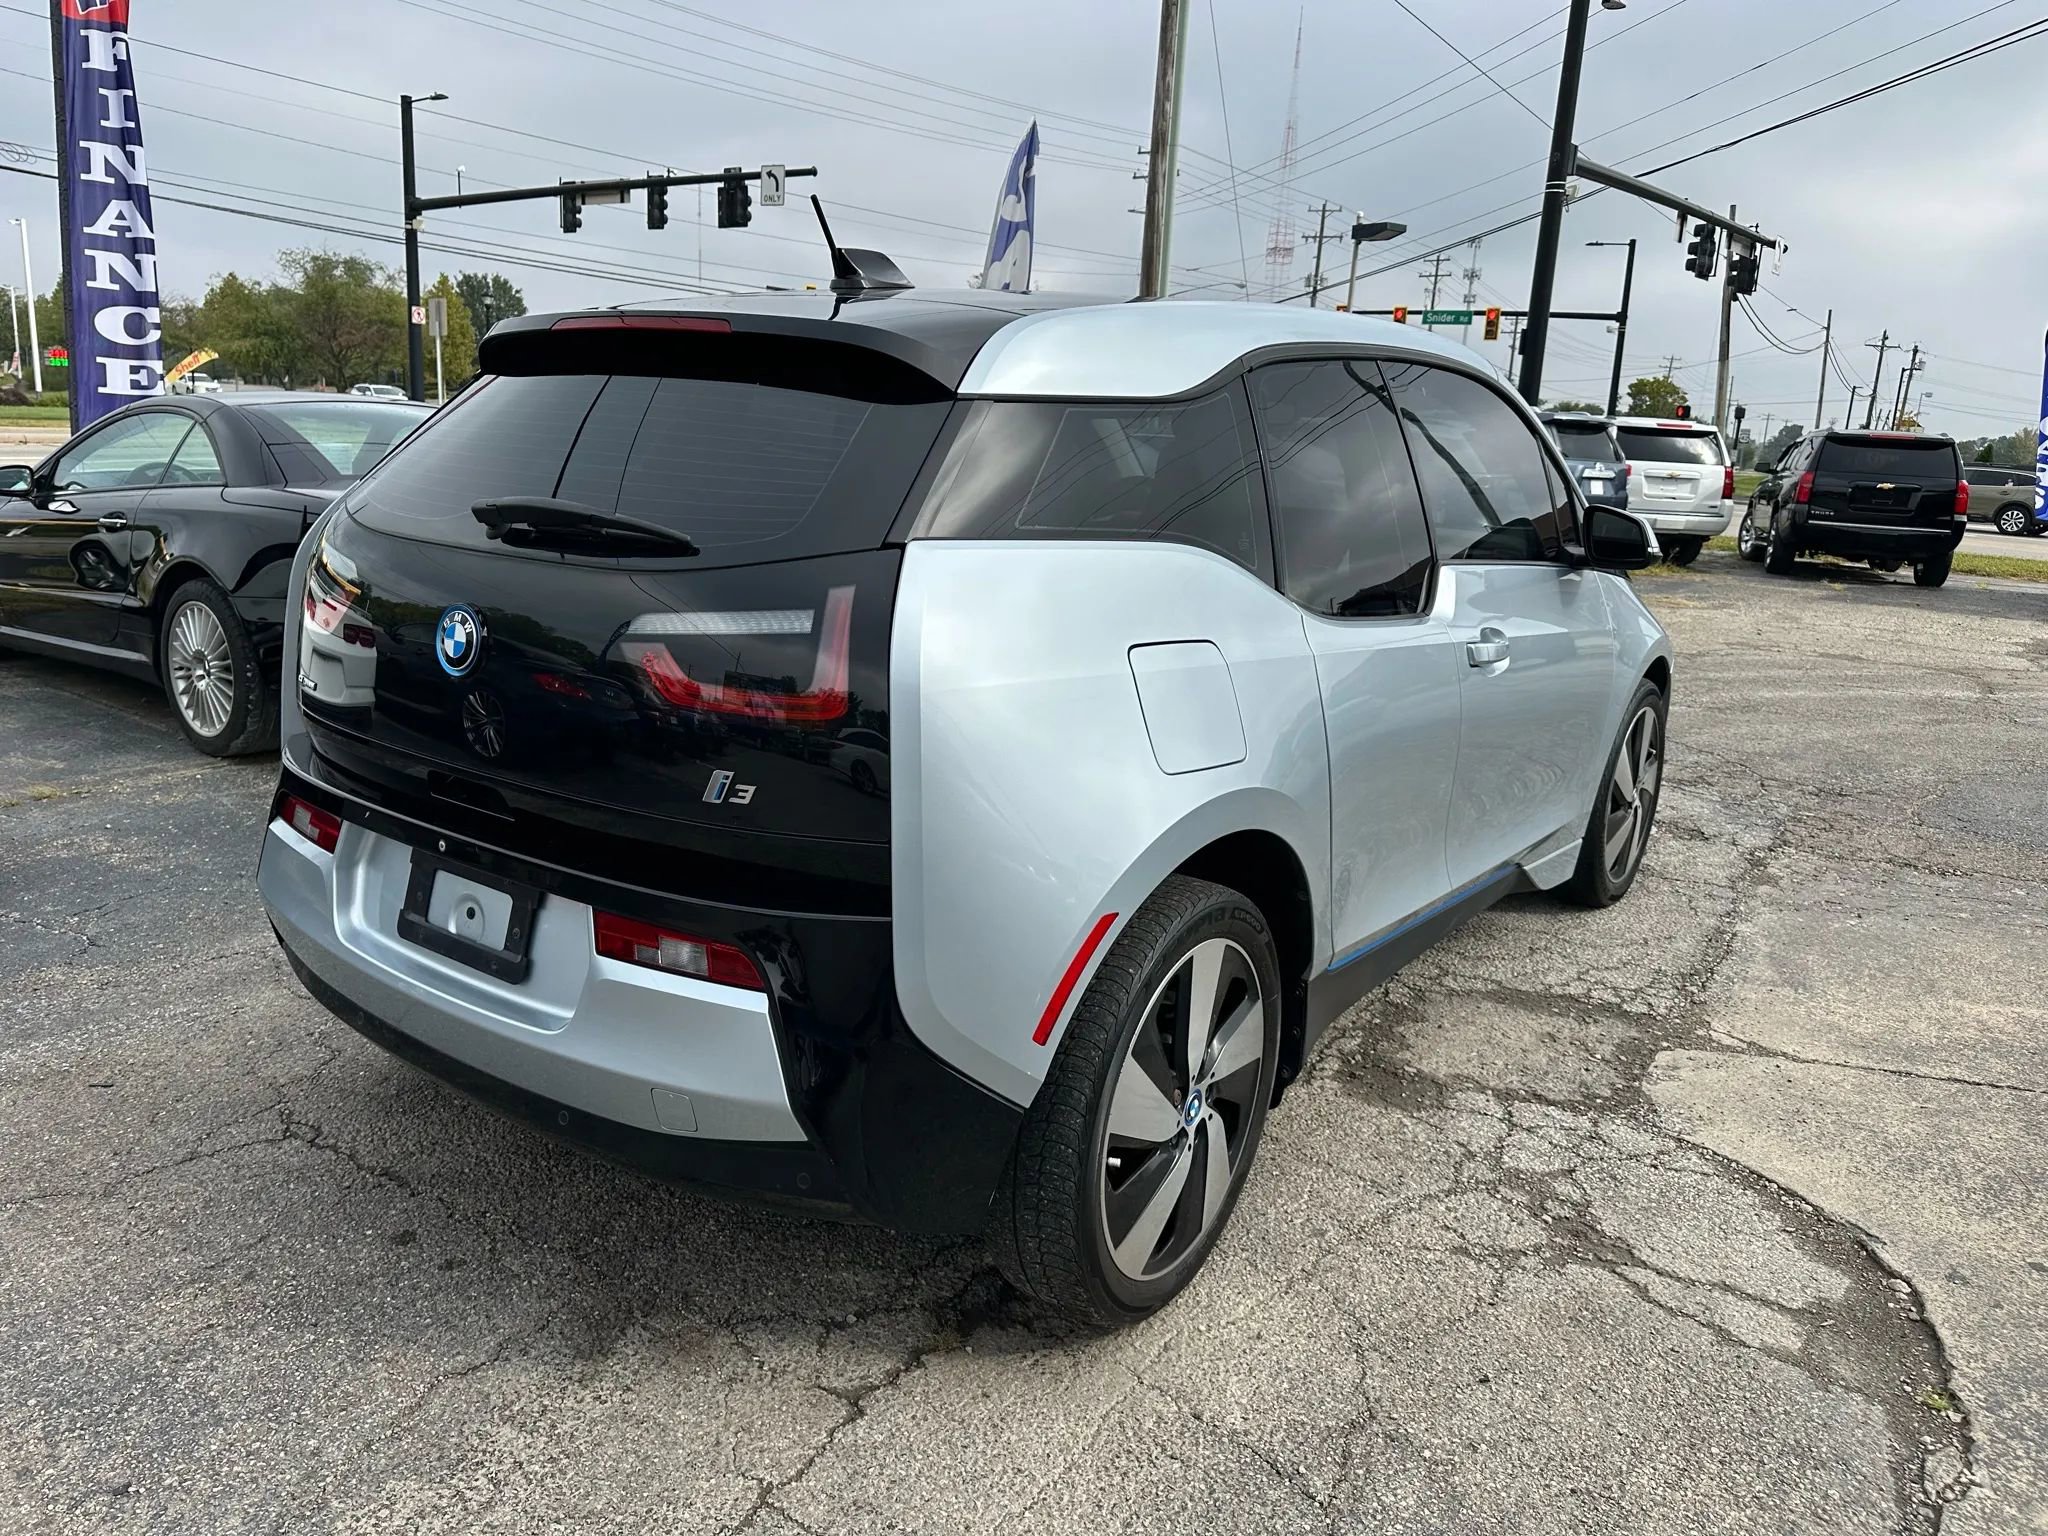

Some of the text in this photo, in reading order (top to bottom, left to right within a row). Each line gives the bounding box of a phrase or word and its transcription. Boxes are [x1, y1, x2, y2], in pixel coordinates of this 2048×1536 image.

[763, 193, 781, 203] ONLY
[79, 28, 166, 396] FINANCE
[1426, 312, 1469, 322] Snider Rd
[175, 353, 201, 376] Shell
[702, 769, 757, 805] i3
